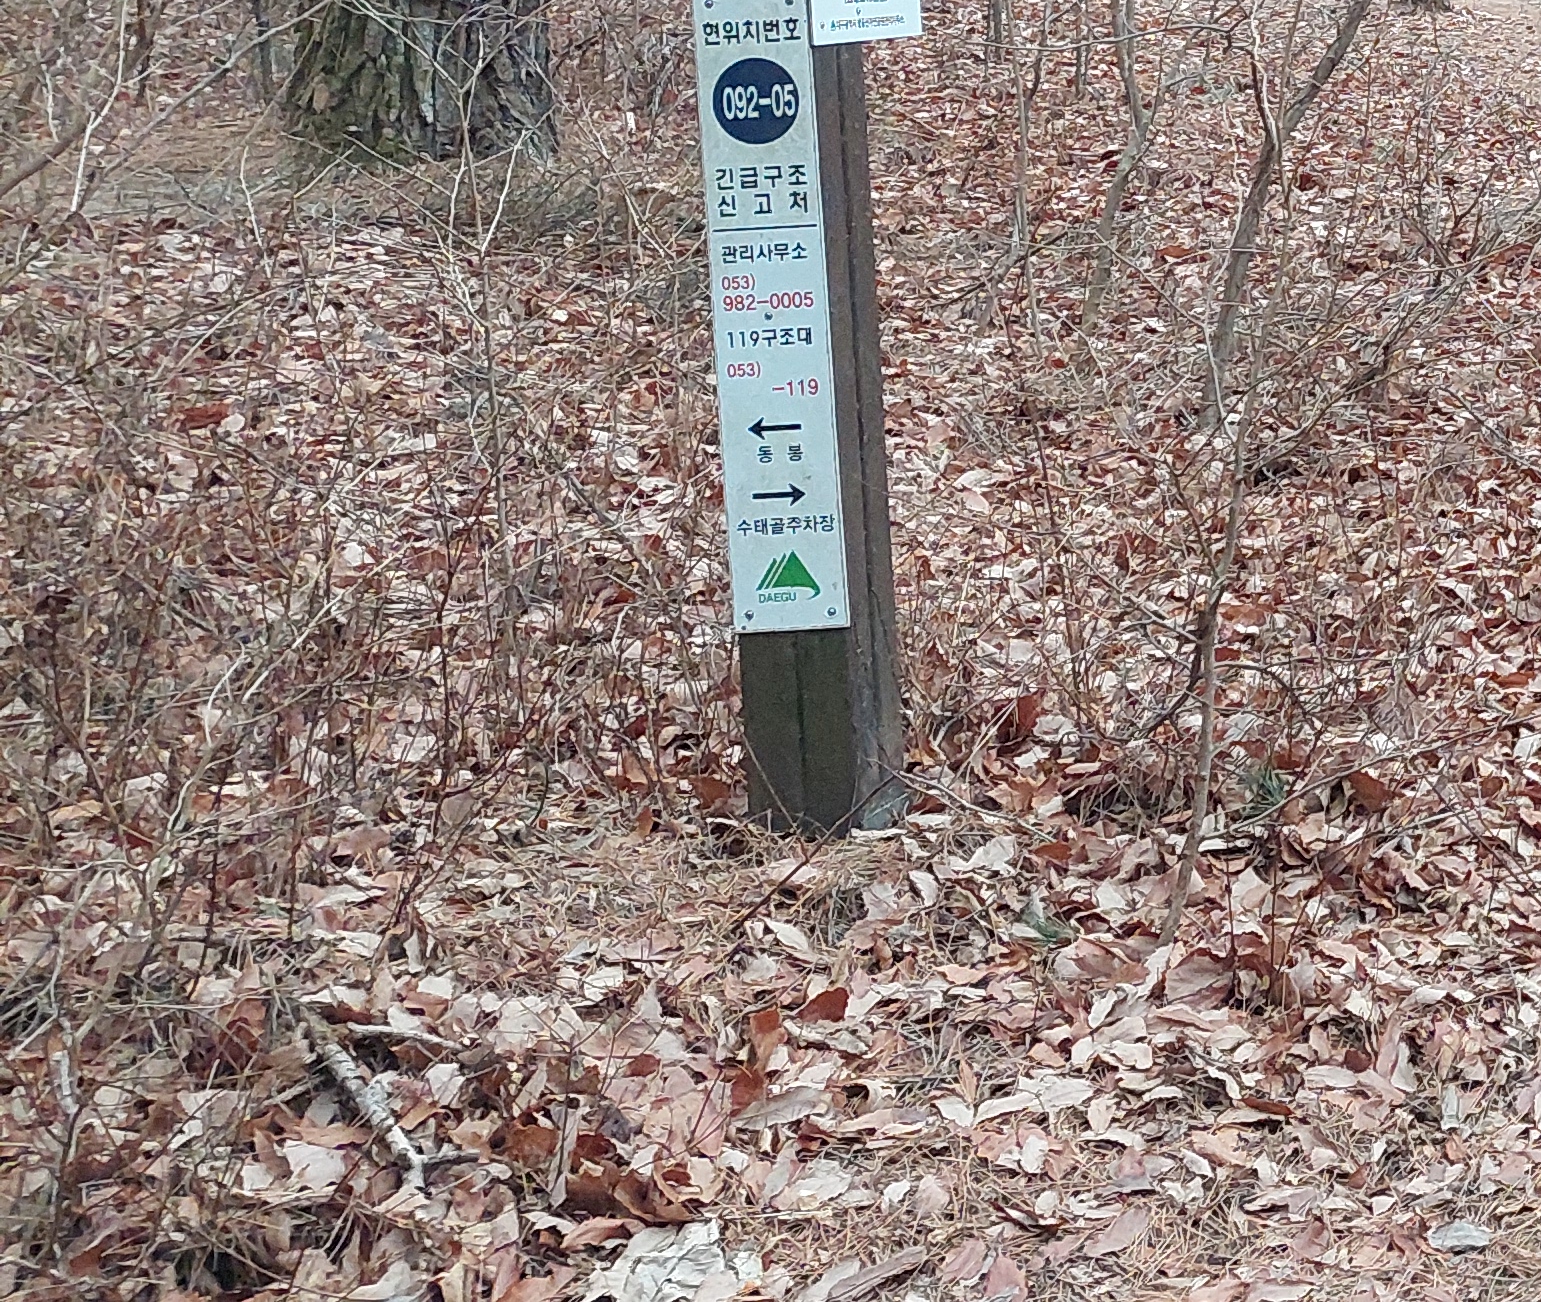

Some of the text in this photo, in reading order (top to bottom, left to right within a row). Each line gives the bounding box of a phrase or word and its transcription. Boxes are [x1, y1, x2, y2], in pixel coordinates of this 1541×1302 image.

[701, 16, 803, 47] 현위치번호
[721, 82, 796, 120] 092-05
[714, 163, 809, 191] 긴급구조
[720, 240, 809, 264] 관리사무소
[721, 273, 756, 292] 053)
[722, 291, 815, 313] 982-0005
[727, 326, 814, 349] 119구조대
[727, 361, 762, 379] 053)
[772, 380, 820, 397] -119
[736, 513, 836, 536] 수태골주차장
[757, 590, 797, 604] DAEGU
